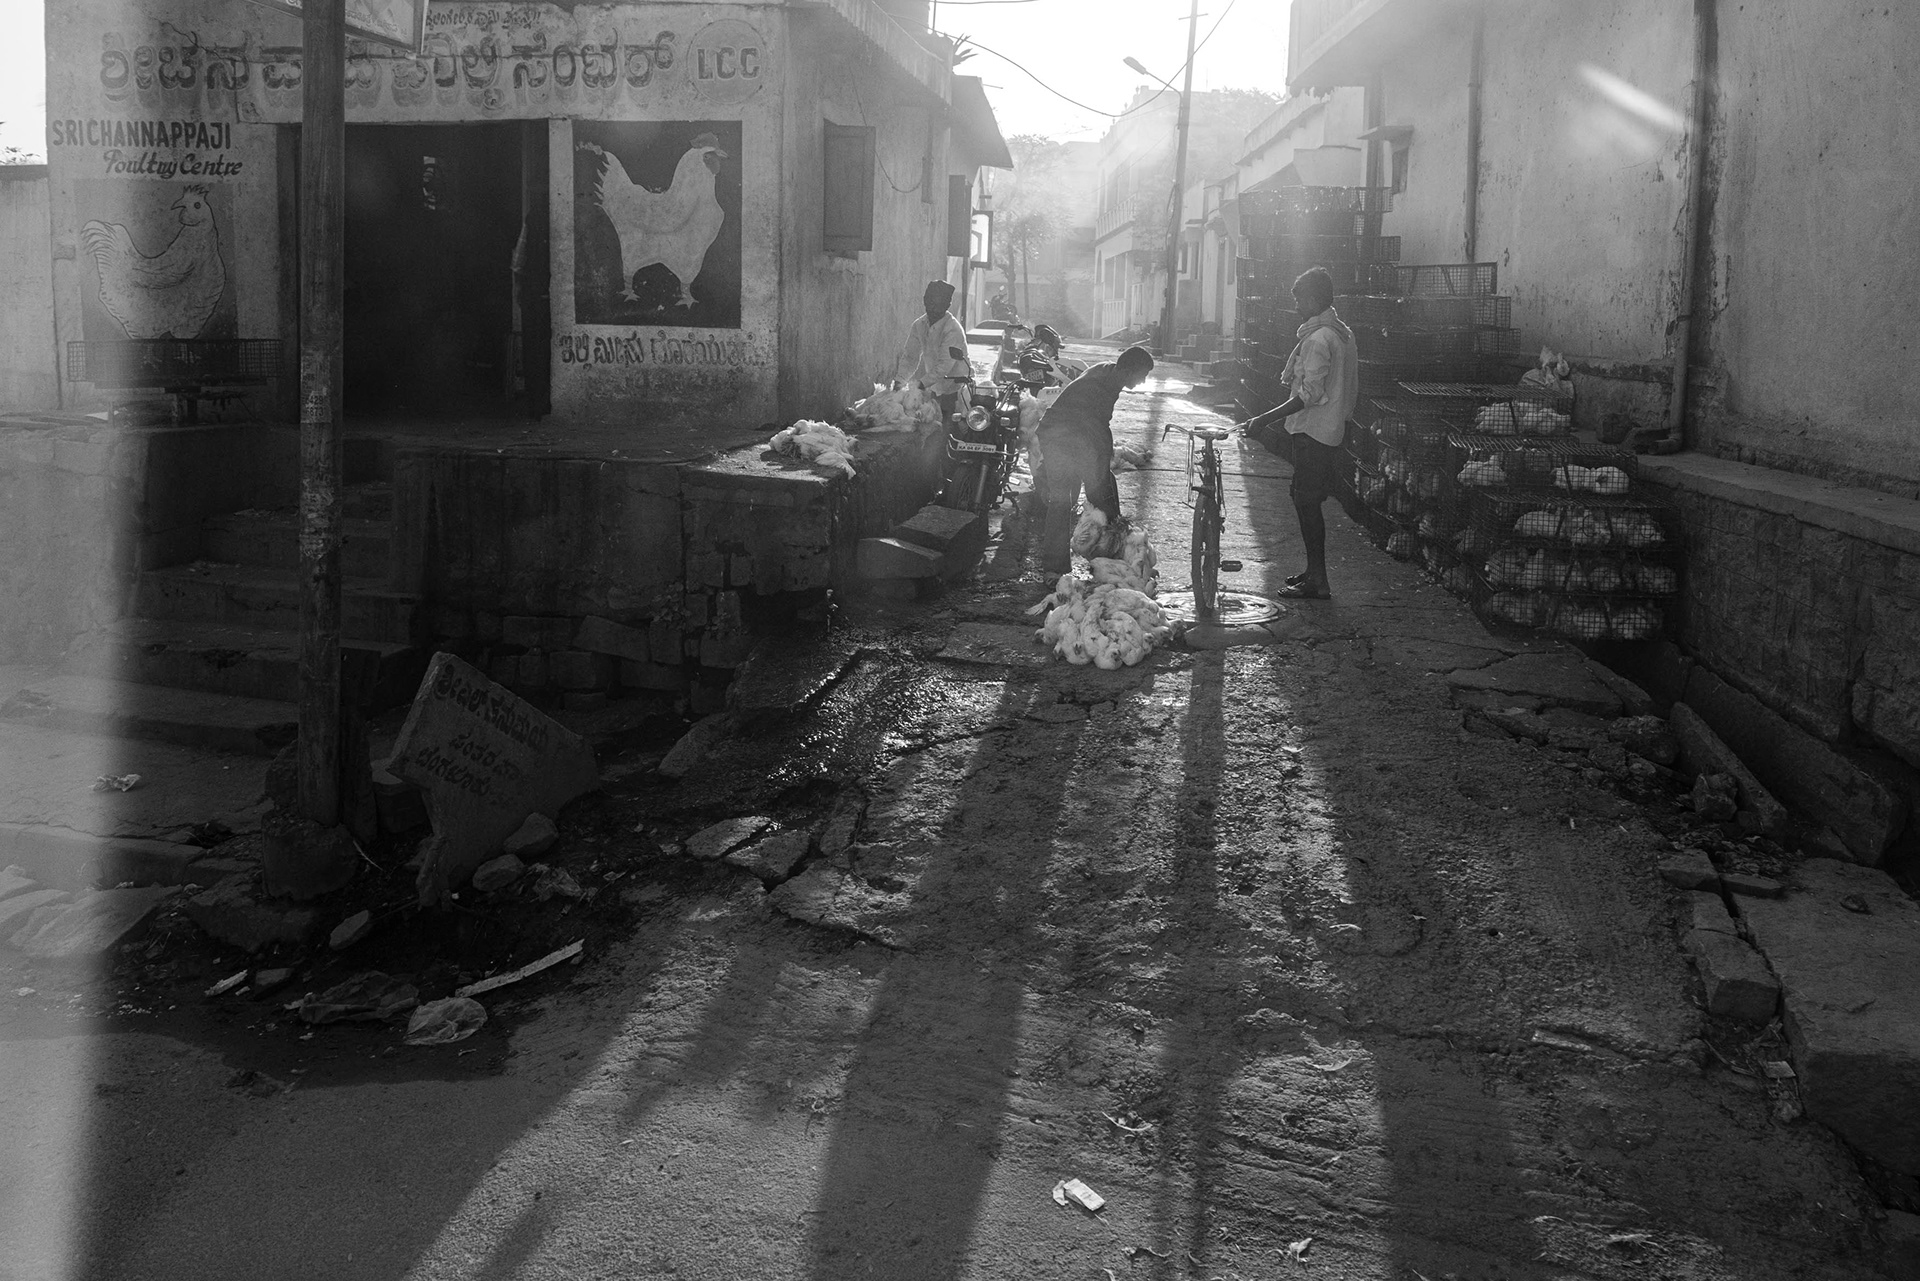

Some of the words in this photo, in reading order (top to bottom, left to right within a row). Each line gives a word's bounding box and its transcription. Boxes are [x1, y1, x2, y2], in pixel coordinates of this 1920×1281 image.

[697, 46, 761, 80] LCC
[102, 149, 178, 180] Poultry
[179, 153, 243, 177] Centre
